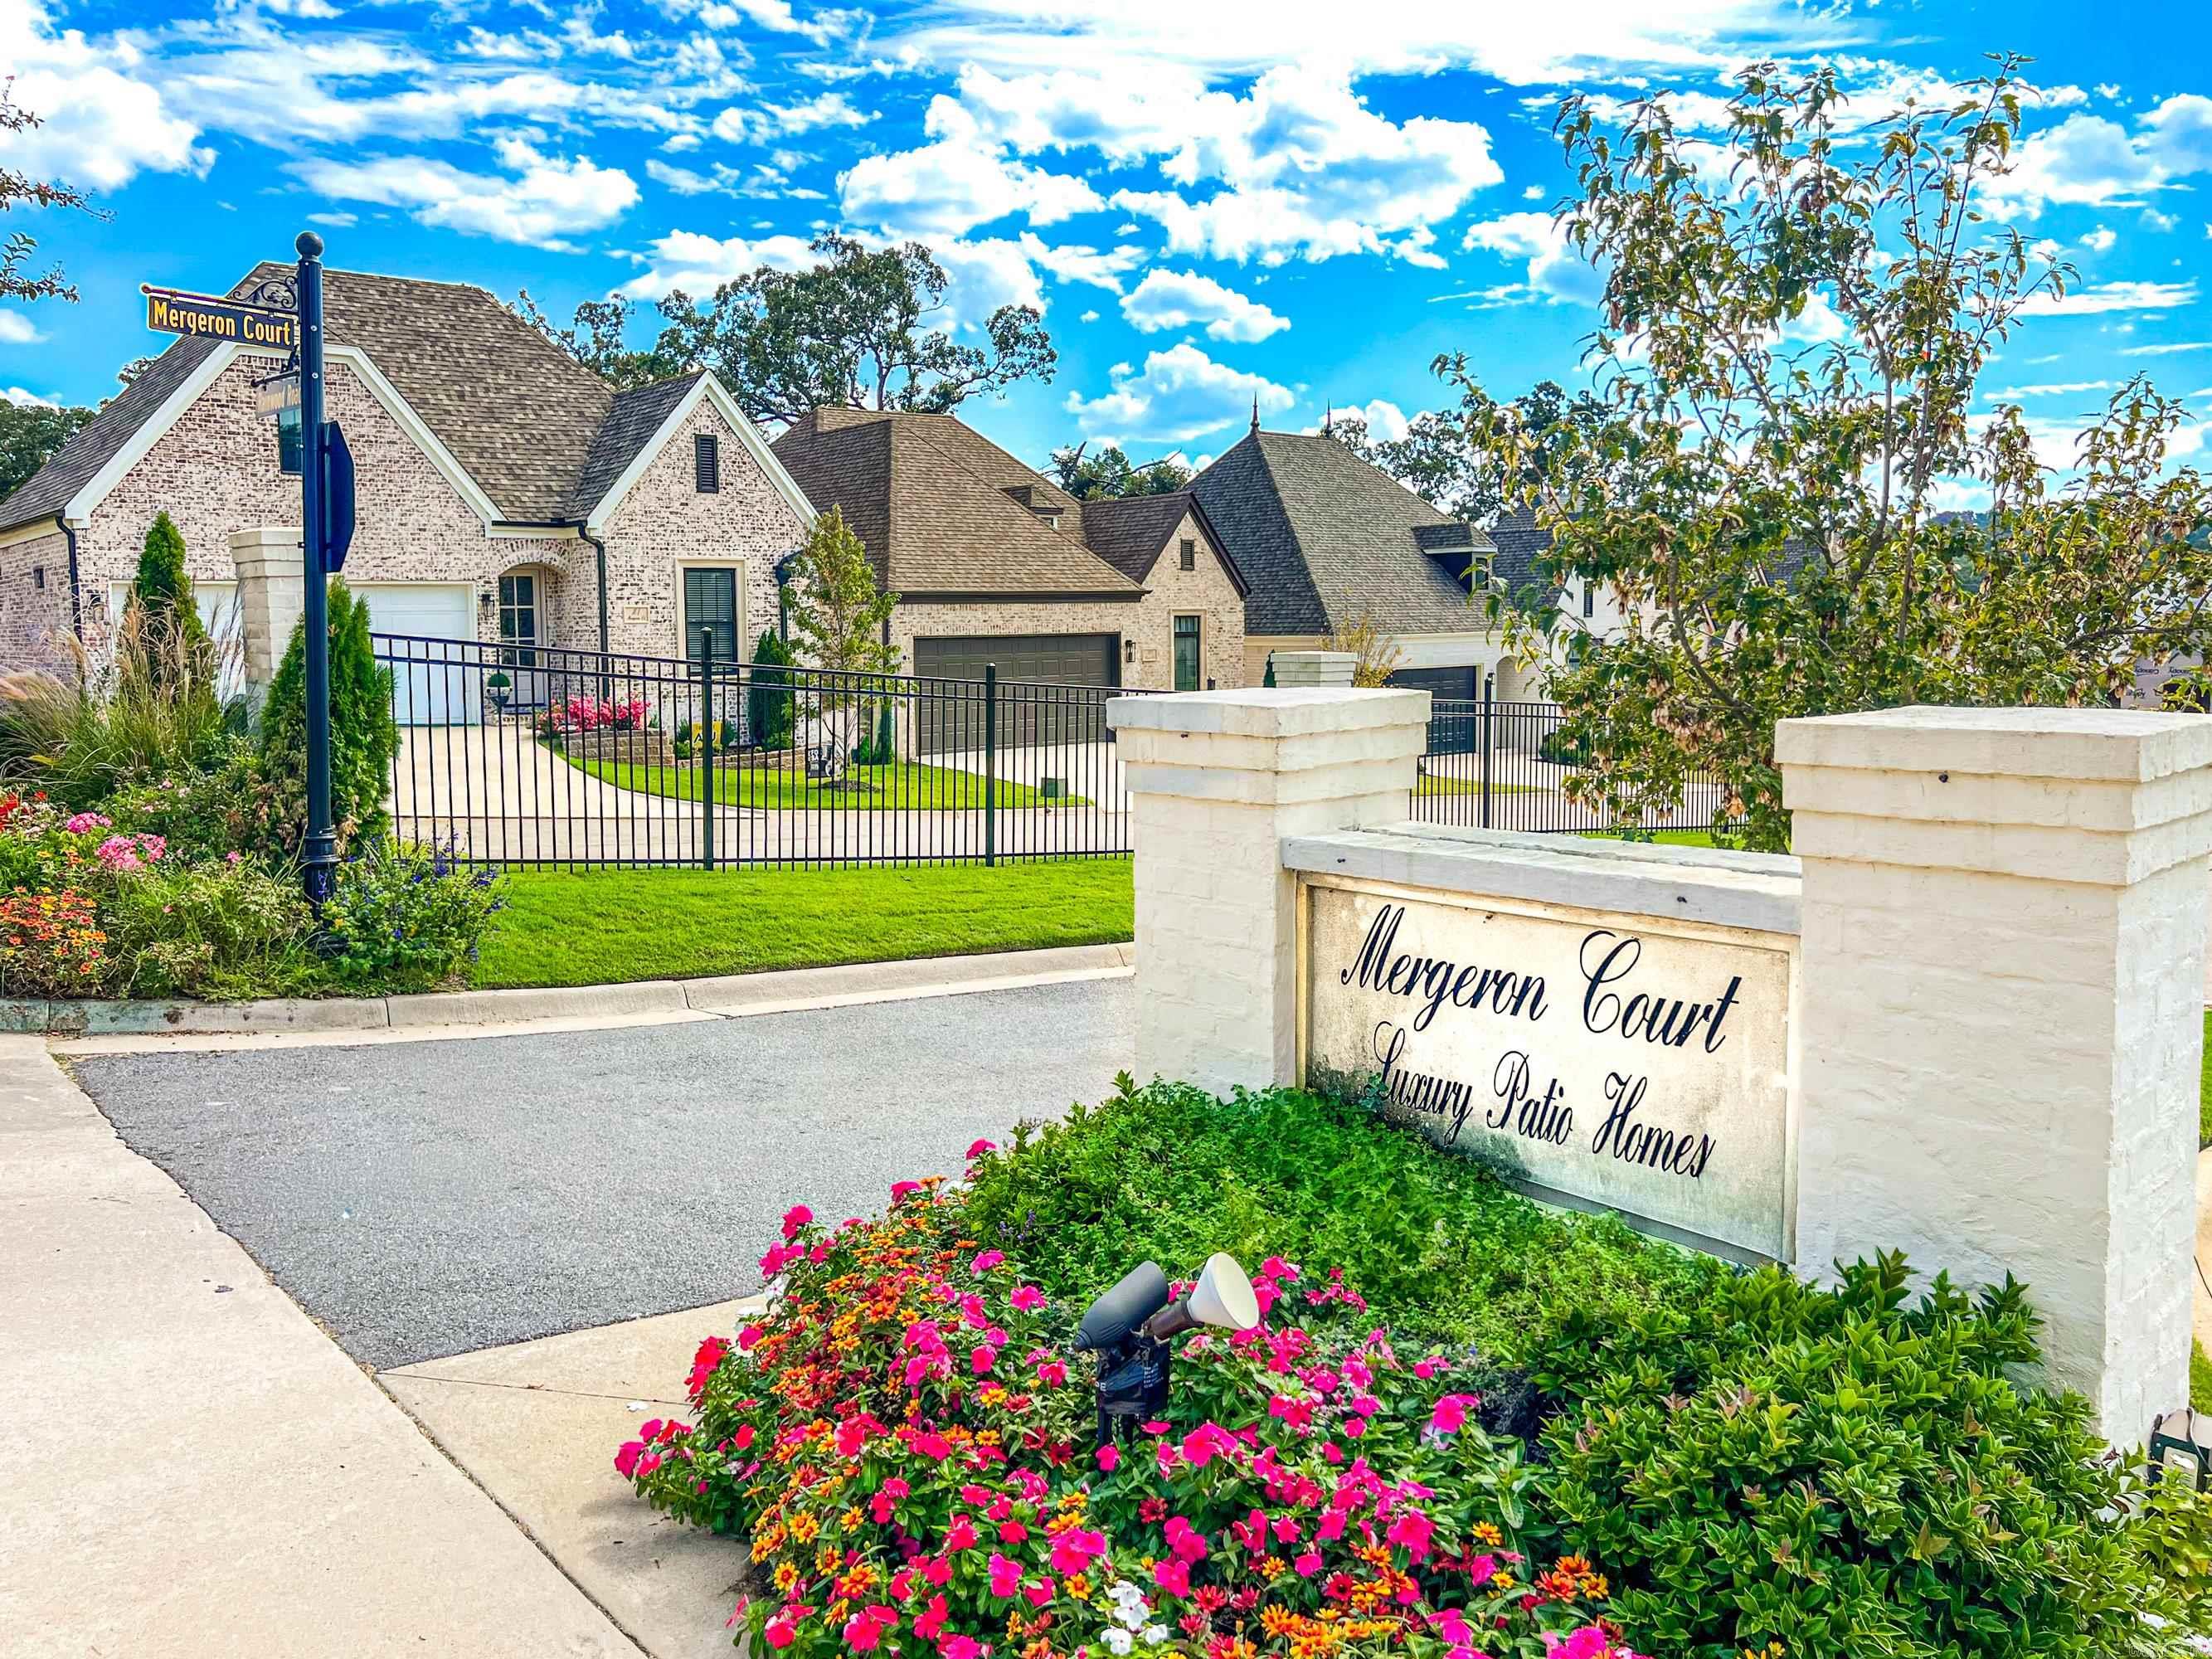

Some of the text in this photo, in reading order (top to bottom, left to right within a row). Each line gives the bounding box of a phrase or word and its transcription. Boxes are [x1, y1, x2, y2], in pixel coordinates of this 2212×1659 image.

[153, 300, 290, 345] Mergeron Court
[1341, 904, 1742, 1053] Mergeron Court
[1369, 1021, 1716, 1178] Luxury Patio Homes
